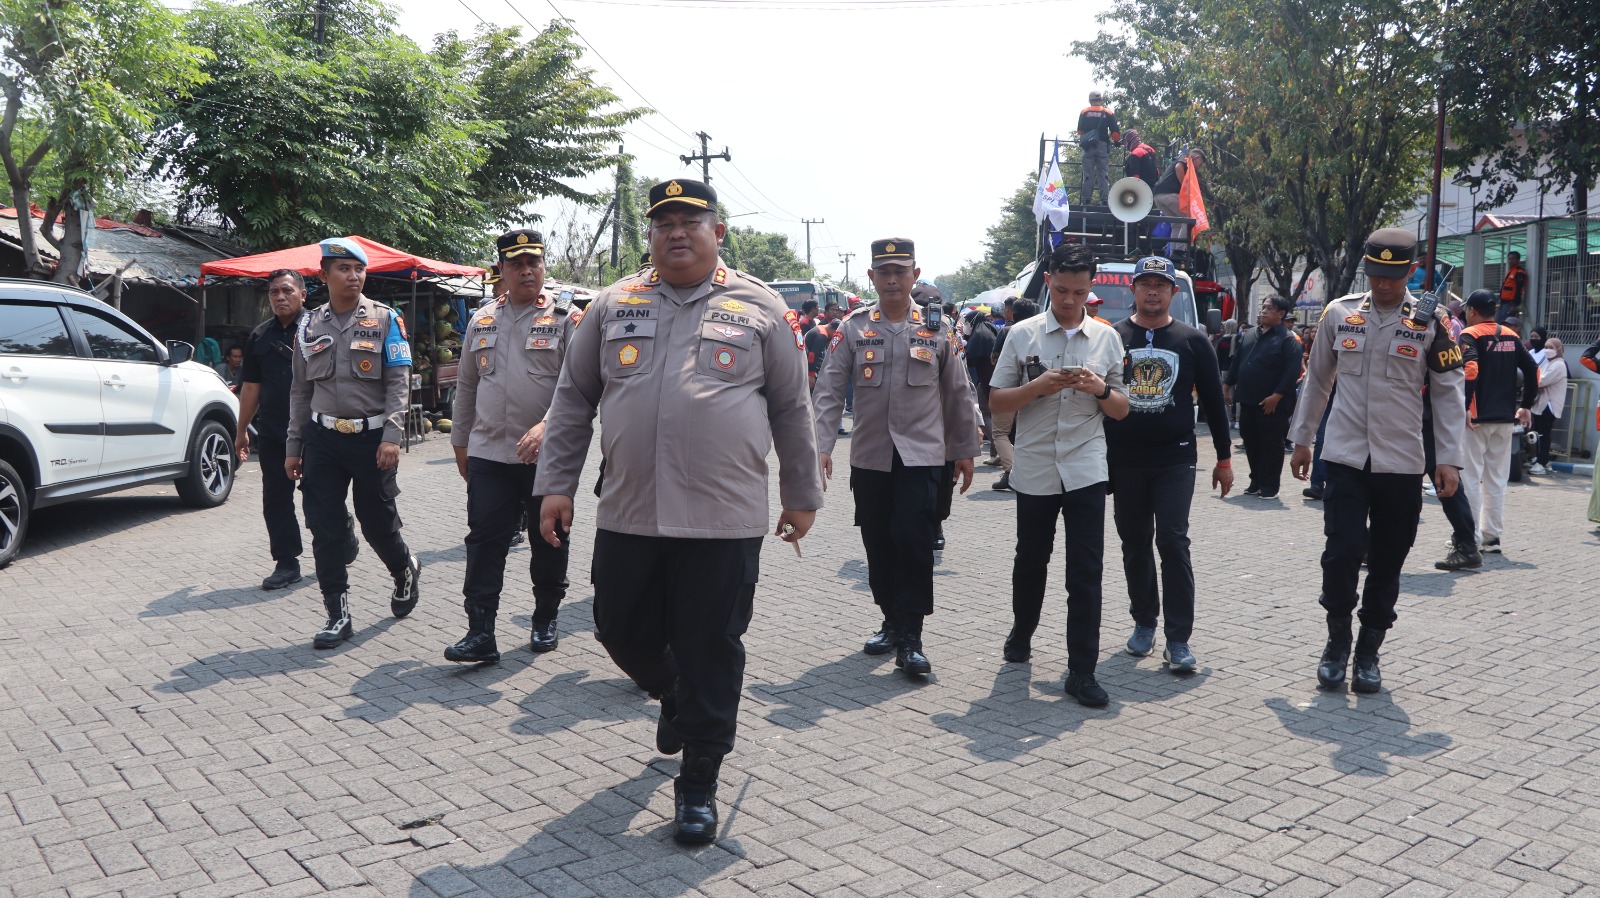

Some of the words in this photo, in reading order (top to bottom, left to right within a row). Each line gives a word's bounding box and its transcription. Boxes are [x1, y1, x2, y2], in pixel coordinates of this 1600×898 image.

[1096, 273, 1133, 286] OMA
[616, 309, 650, 318] DANI
[711, 312, 750, 325] POLRI
[354, 330, 382, 339] POLRI
[530, 327, 559, 335] POLRI
[1395, 329, 1426, 342] POLRI
[911, 338, 938, 348] POLRI
[1129, 385, 1164, 395] COBRA
